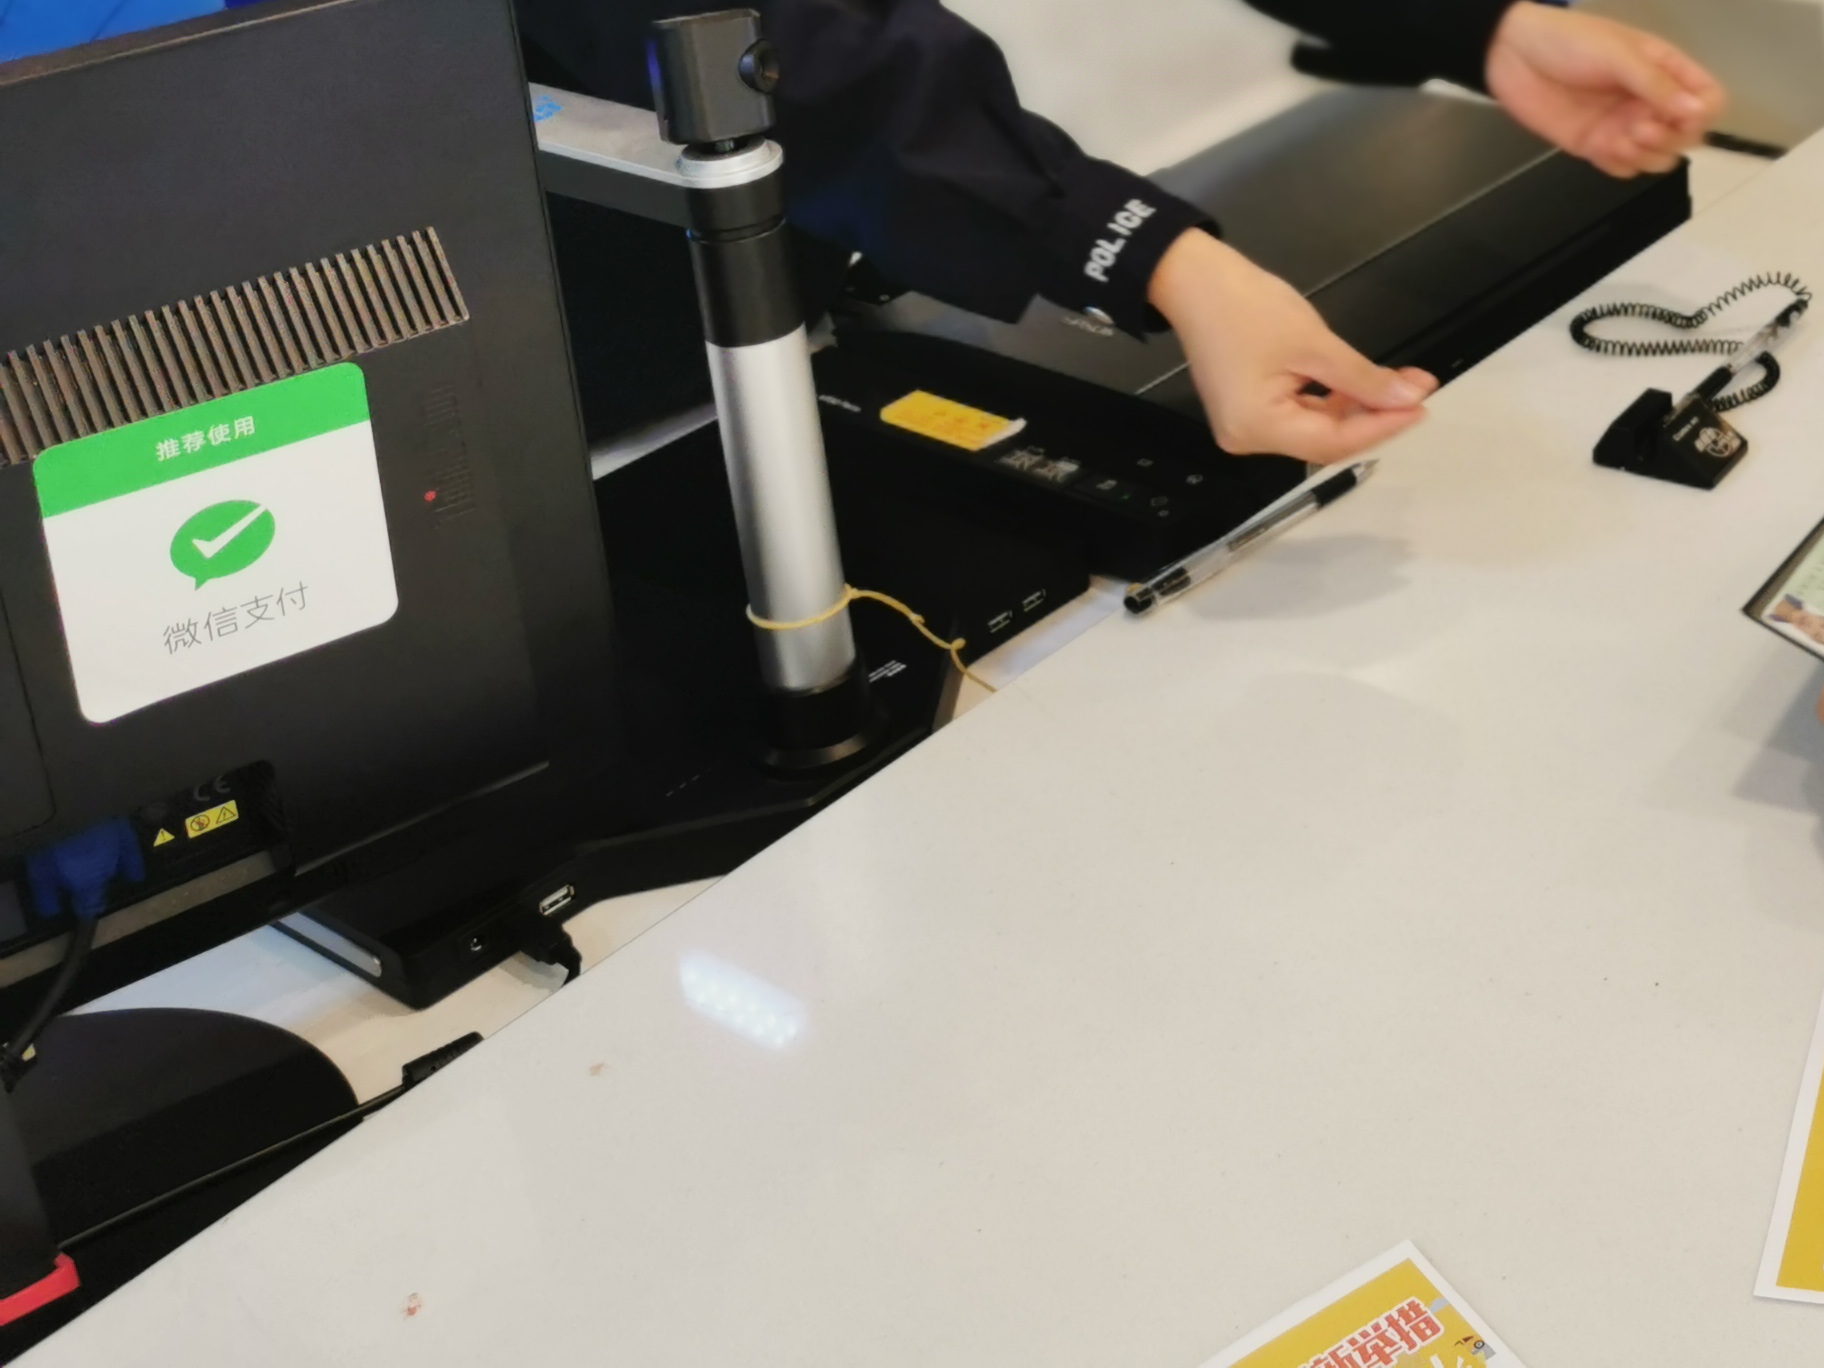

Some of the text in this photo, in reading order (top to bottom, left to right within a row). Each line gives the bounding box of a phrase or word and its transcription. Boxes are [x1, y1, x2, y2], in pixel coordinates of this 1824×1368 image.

[1083, 197, 1157, 283] POLICE
[155, 414, 257, 463] 推荐使用
[161, 580, 310, 656] 微信支付
